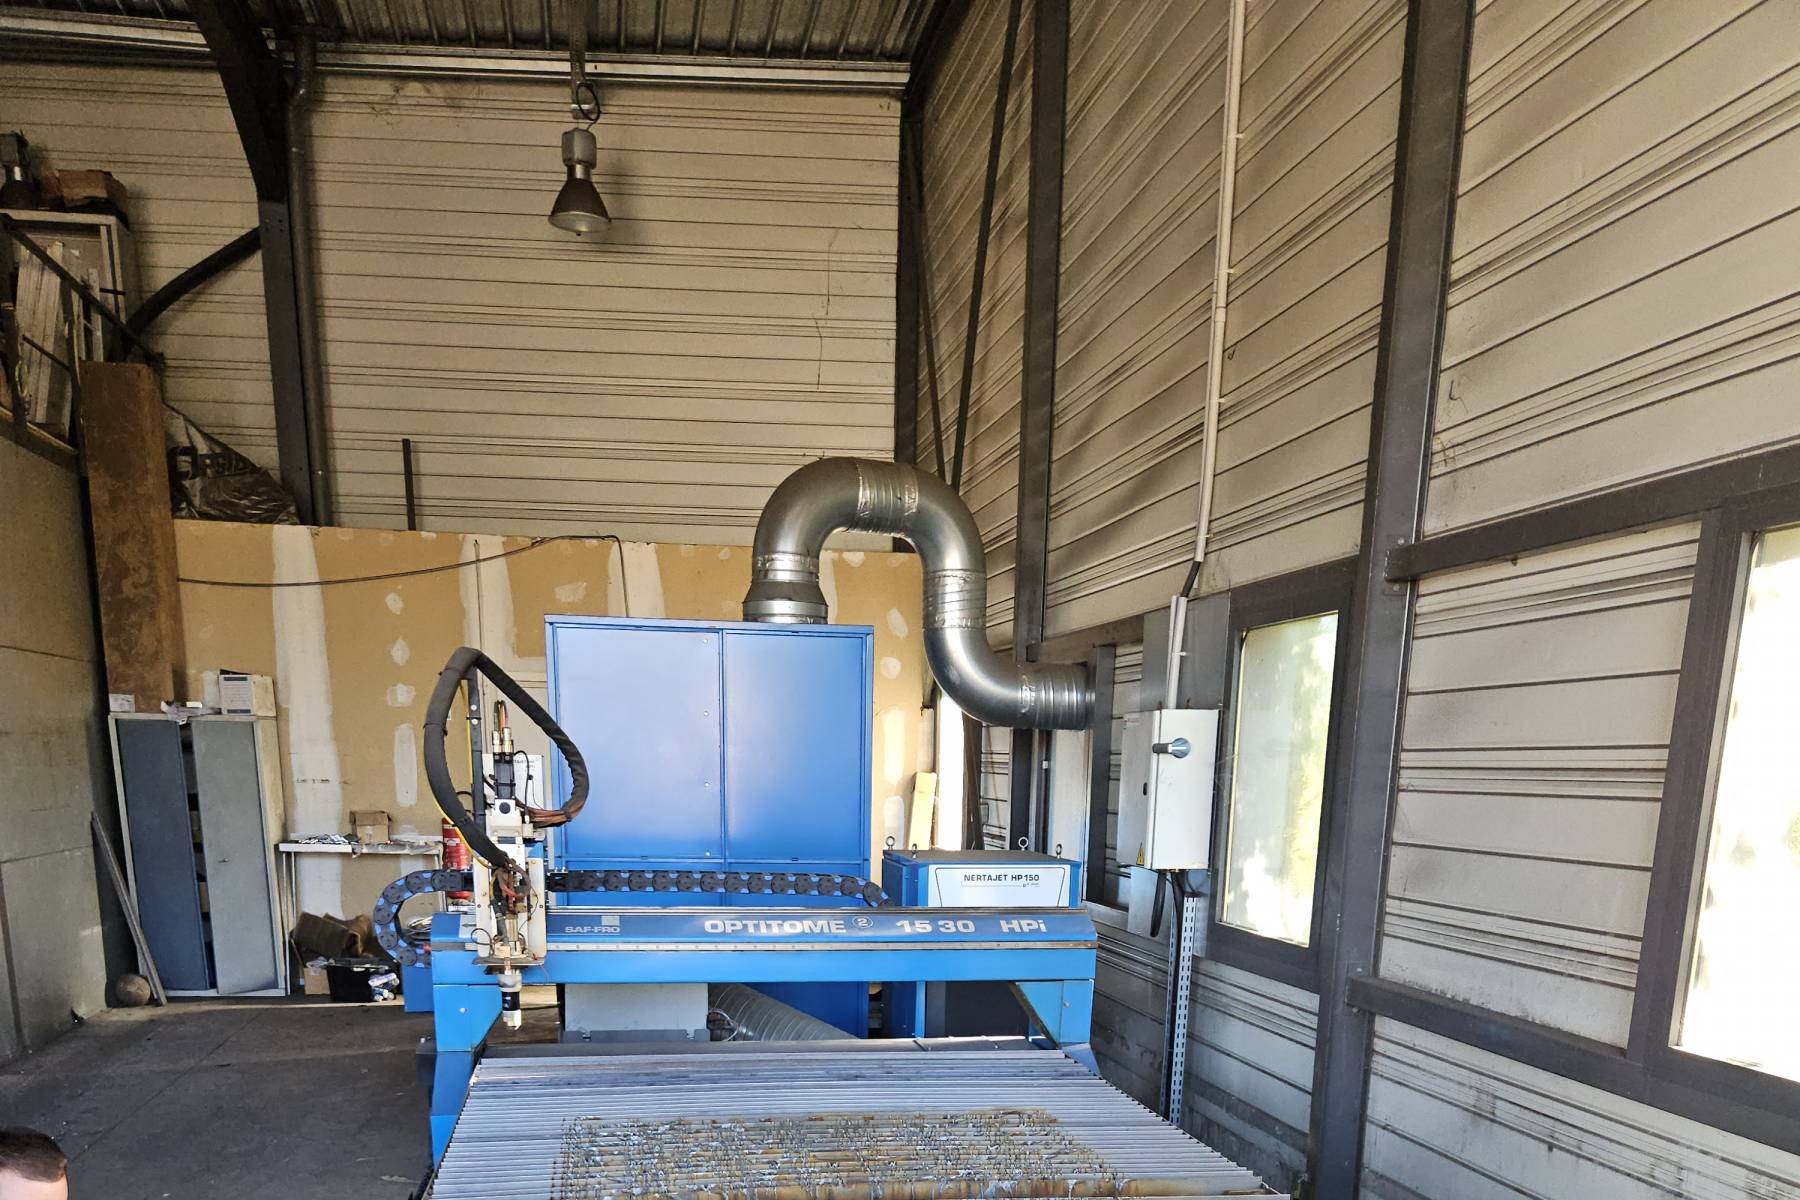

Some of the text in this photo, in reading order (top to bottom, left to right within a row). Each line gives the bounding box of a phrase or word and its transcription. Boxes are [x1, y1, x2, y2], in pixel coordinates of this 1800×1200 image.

[963, 874, 1040, 882] NERTAJET HP 150
[704, 920, 847, 934] OPTITOME
[1000, 919, 1048, 933] HPi
